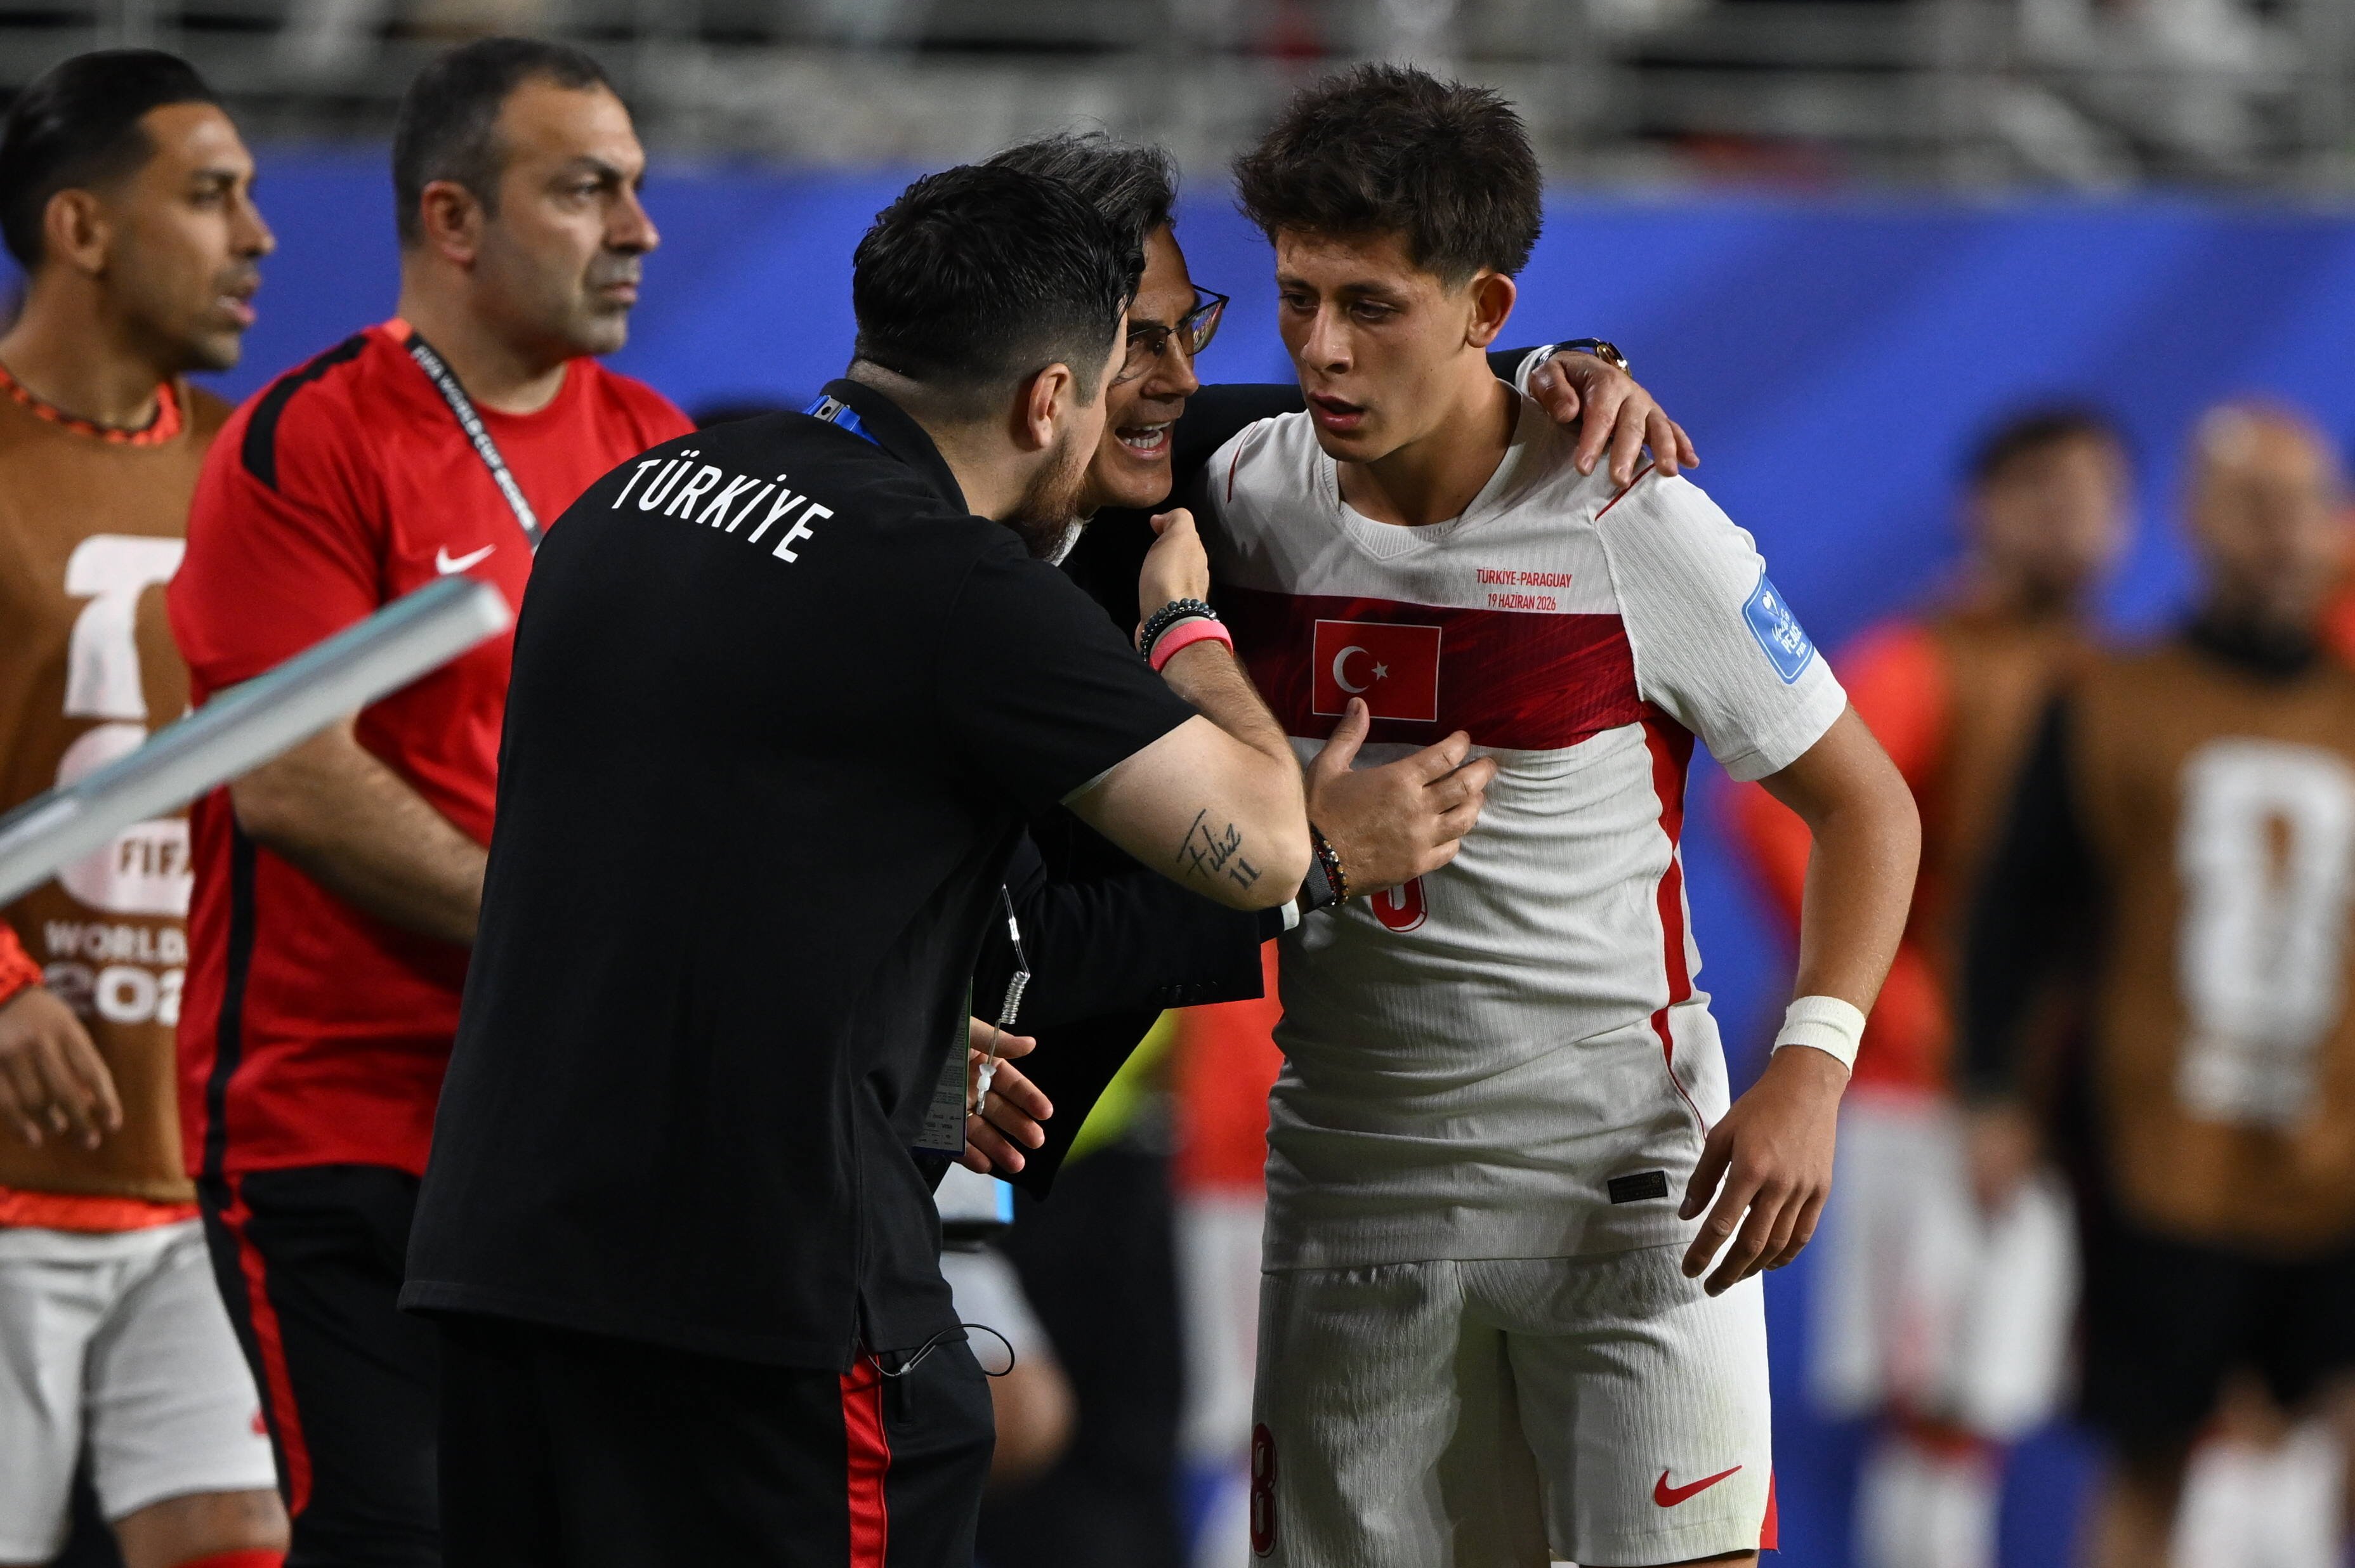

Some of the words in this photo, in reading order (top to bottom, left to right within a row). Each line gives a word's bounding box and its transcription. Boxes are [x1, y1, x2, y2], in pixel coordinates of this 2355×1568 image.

[612, 449, 834, 563] TÜRKİYE
[1476, 567, 1572, 587] TÜRKİYE-PARAGUAY
[1488, 592, 1497, 607] 19
[1499, 592, 1535, 610] HAZİRAN
[1537, 596, 1557, 611] 2026
[121, 839, 193, 875] FIF
[1250, 1423, 1277, 1557] 8
